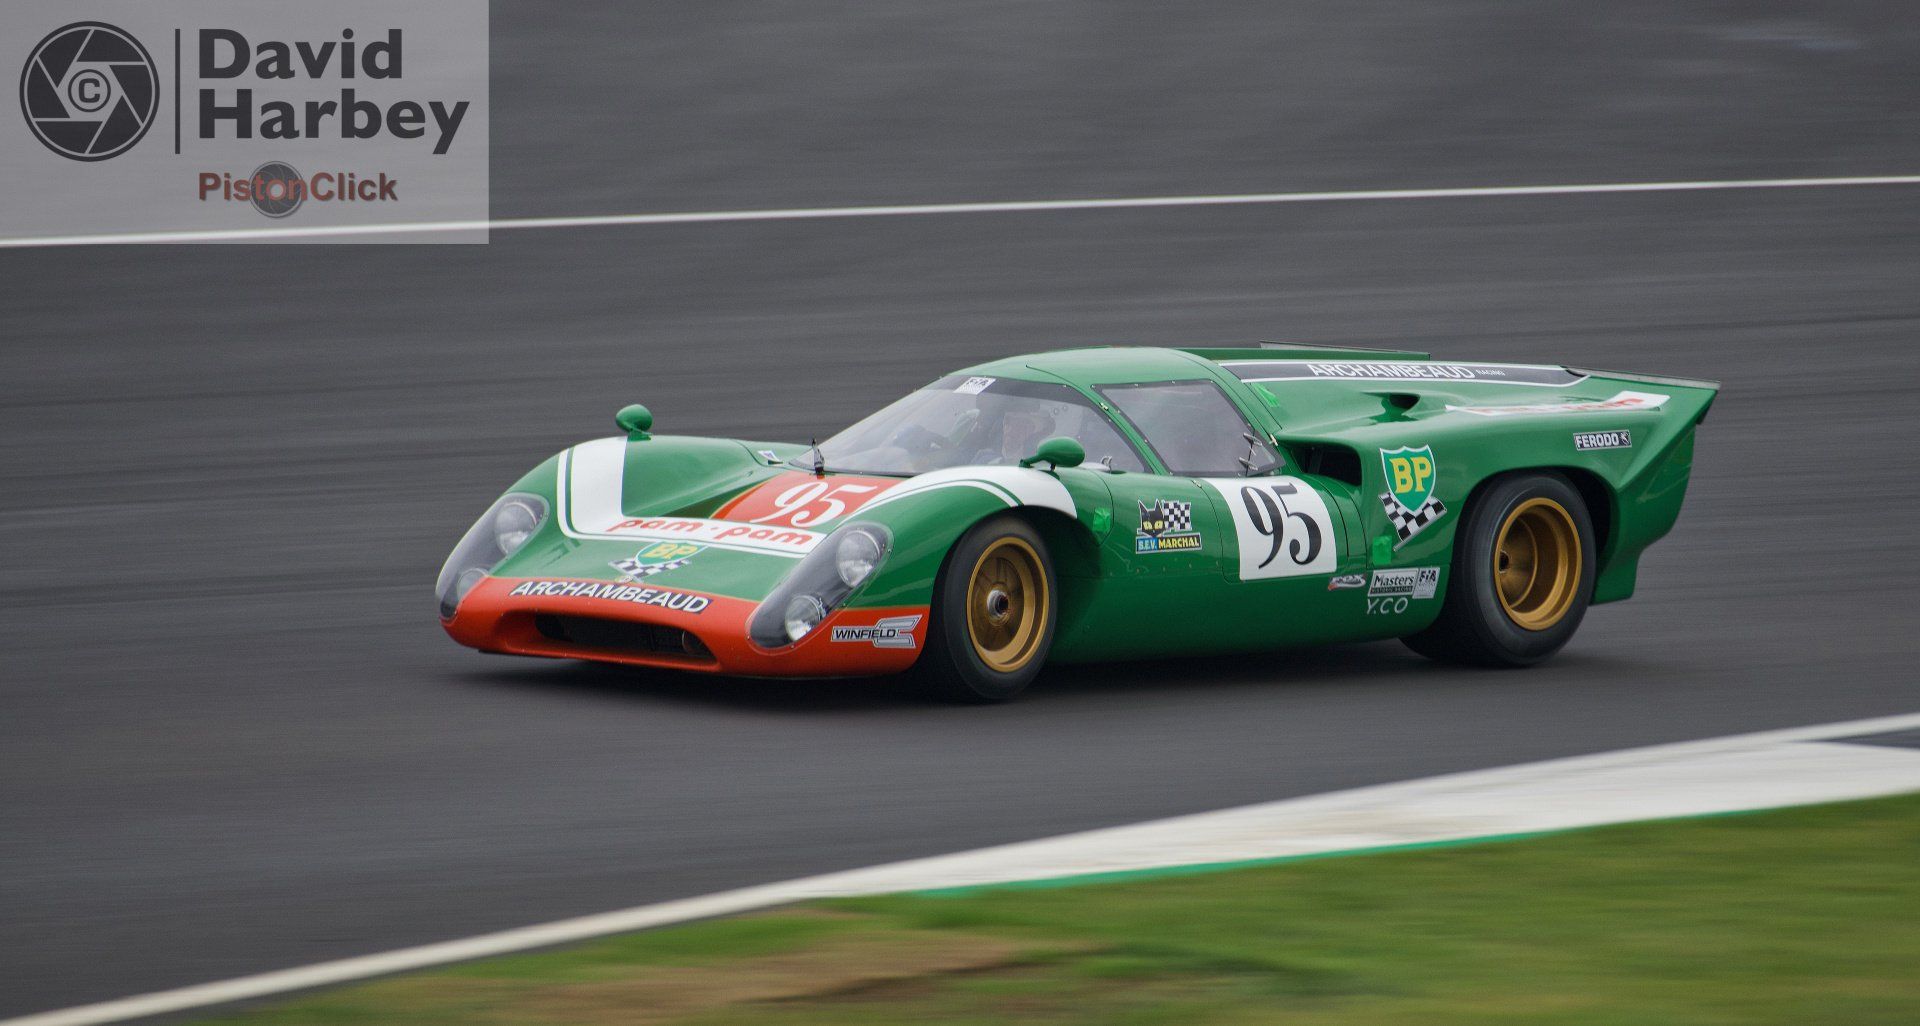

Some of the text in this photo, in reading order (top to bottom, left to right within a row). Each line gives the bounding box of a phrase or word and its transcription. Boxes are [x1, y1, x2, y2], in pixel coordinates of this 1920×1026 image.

[1307, 363, 1476, 379] ARCHAMBEAUD
[1575, 433, 1620, 449] FERODO
[1389, 456, 1432, 494] BP
[750, 481, 878, 528] 95
[605, 518, 813, 546] pam pam
[1240, 482, 1322, 570] 95
[1158, 536, 1200, 549] MARCHAL
[641, 543, 698, 559] BP
[1373, 575, 1415, 587] Masters
[509, 581, 710, 613] ARCHAMBEAUD
[835, 629, 896, 640] WINFIELD
